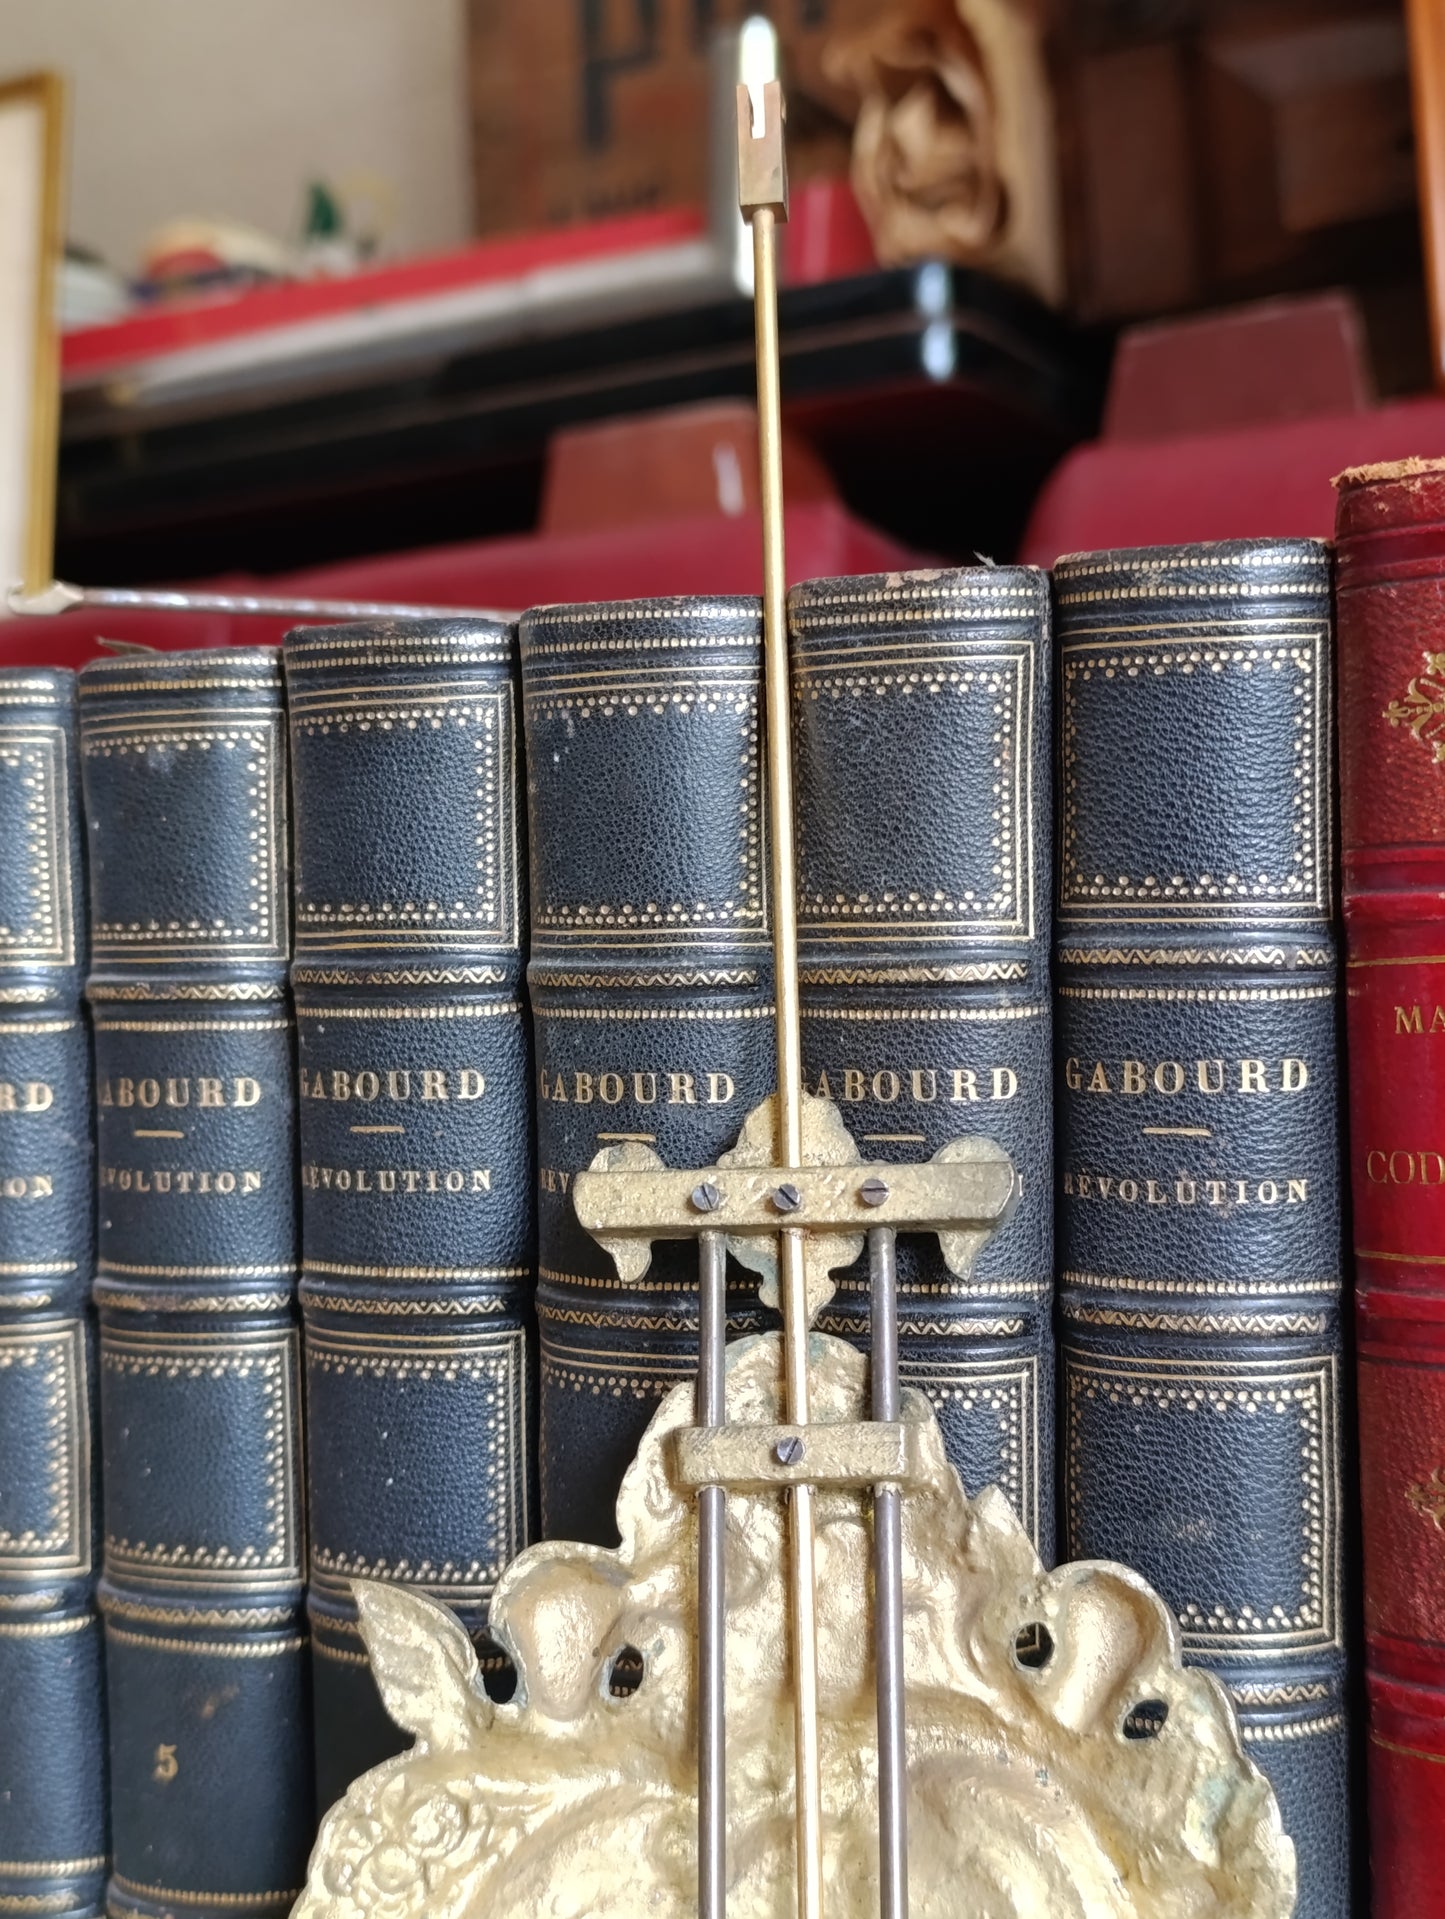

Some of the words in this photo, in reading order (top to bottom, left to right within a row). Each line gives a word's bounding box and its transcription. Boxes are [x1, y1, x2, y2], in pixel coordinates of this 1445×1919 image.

[539, 1068, 735, 1104] GABOURD
[1065, 1057, 1309, 1094] GABOURD
[152, 1743, 179, 1784] 5
